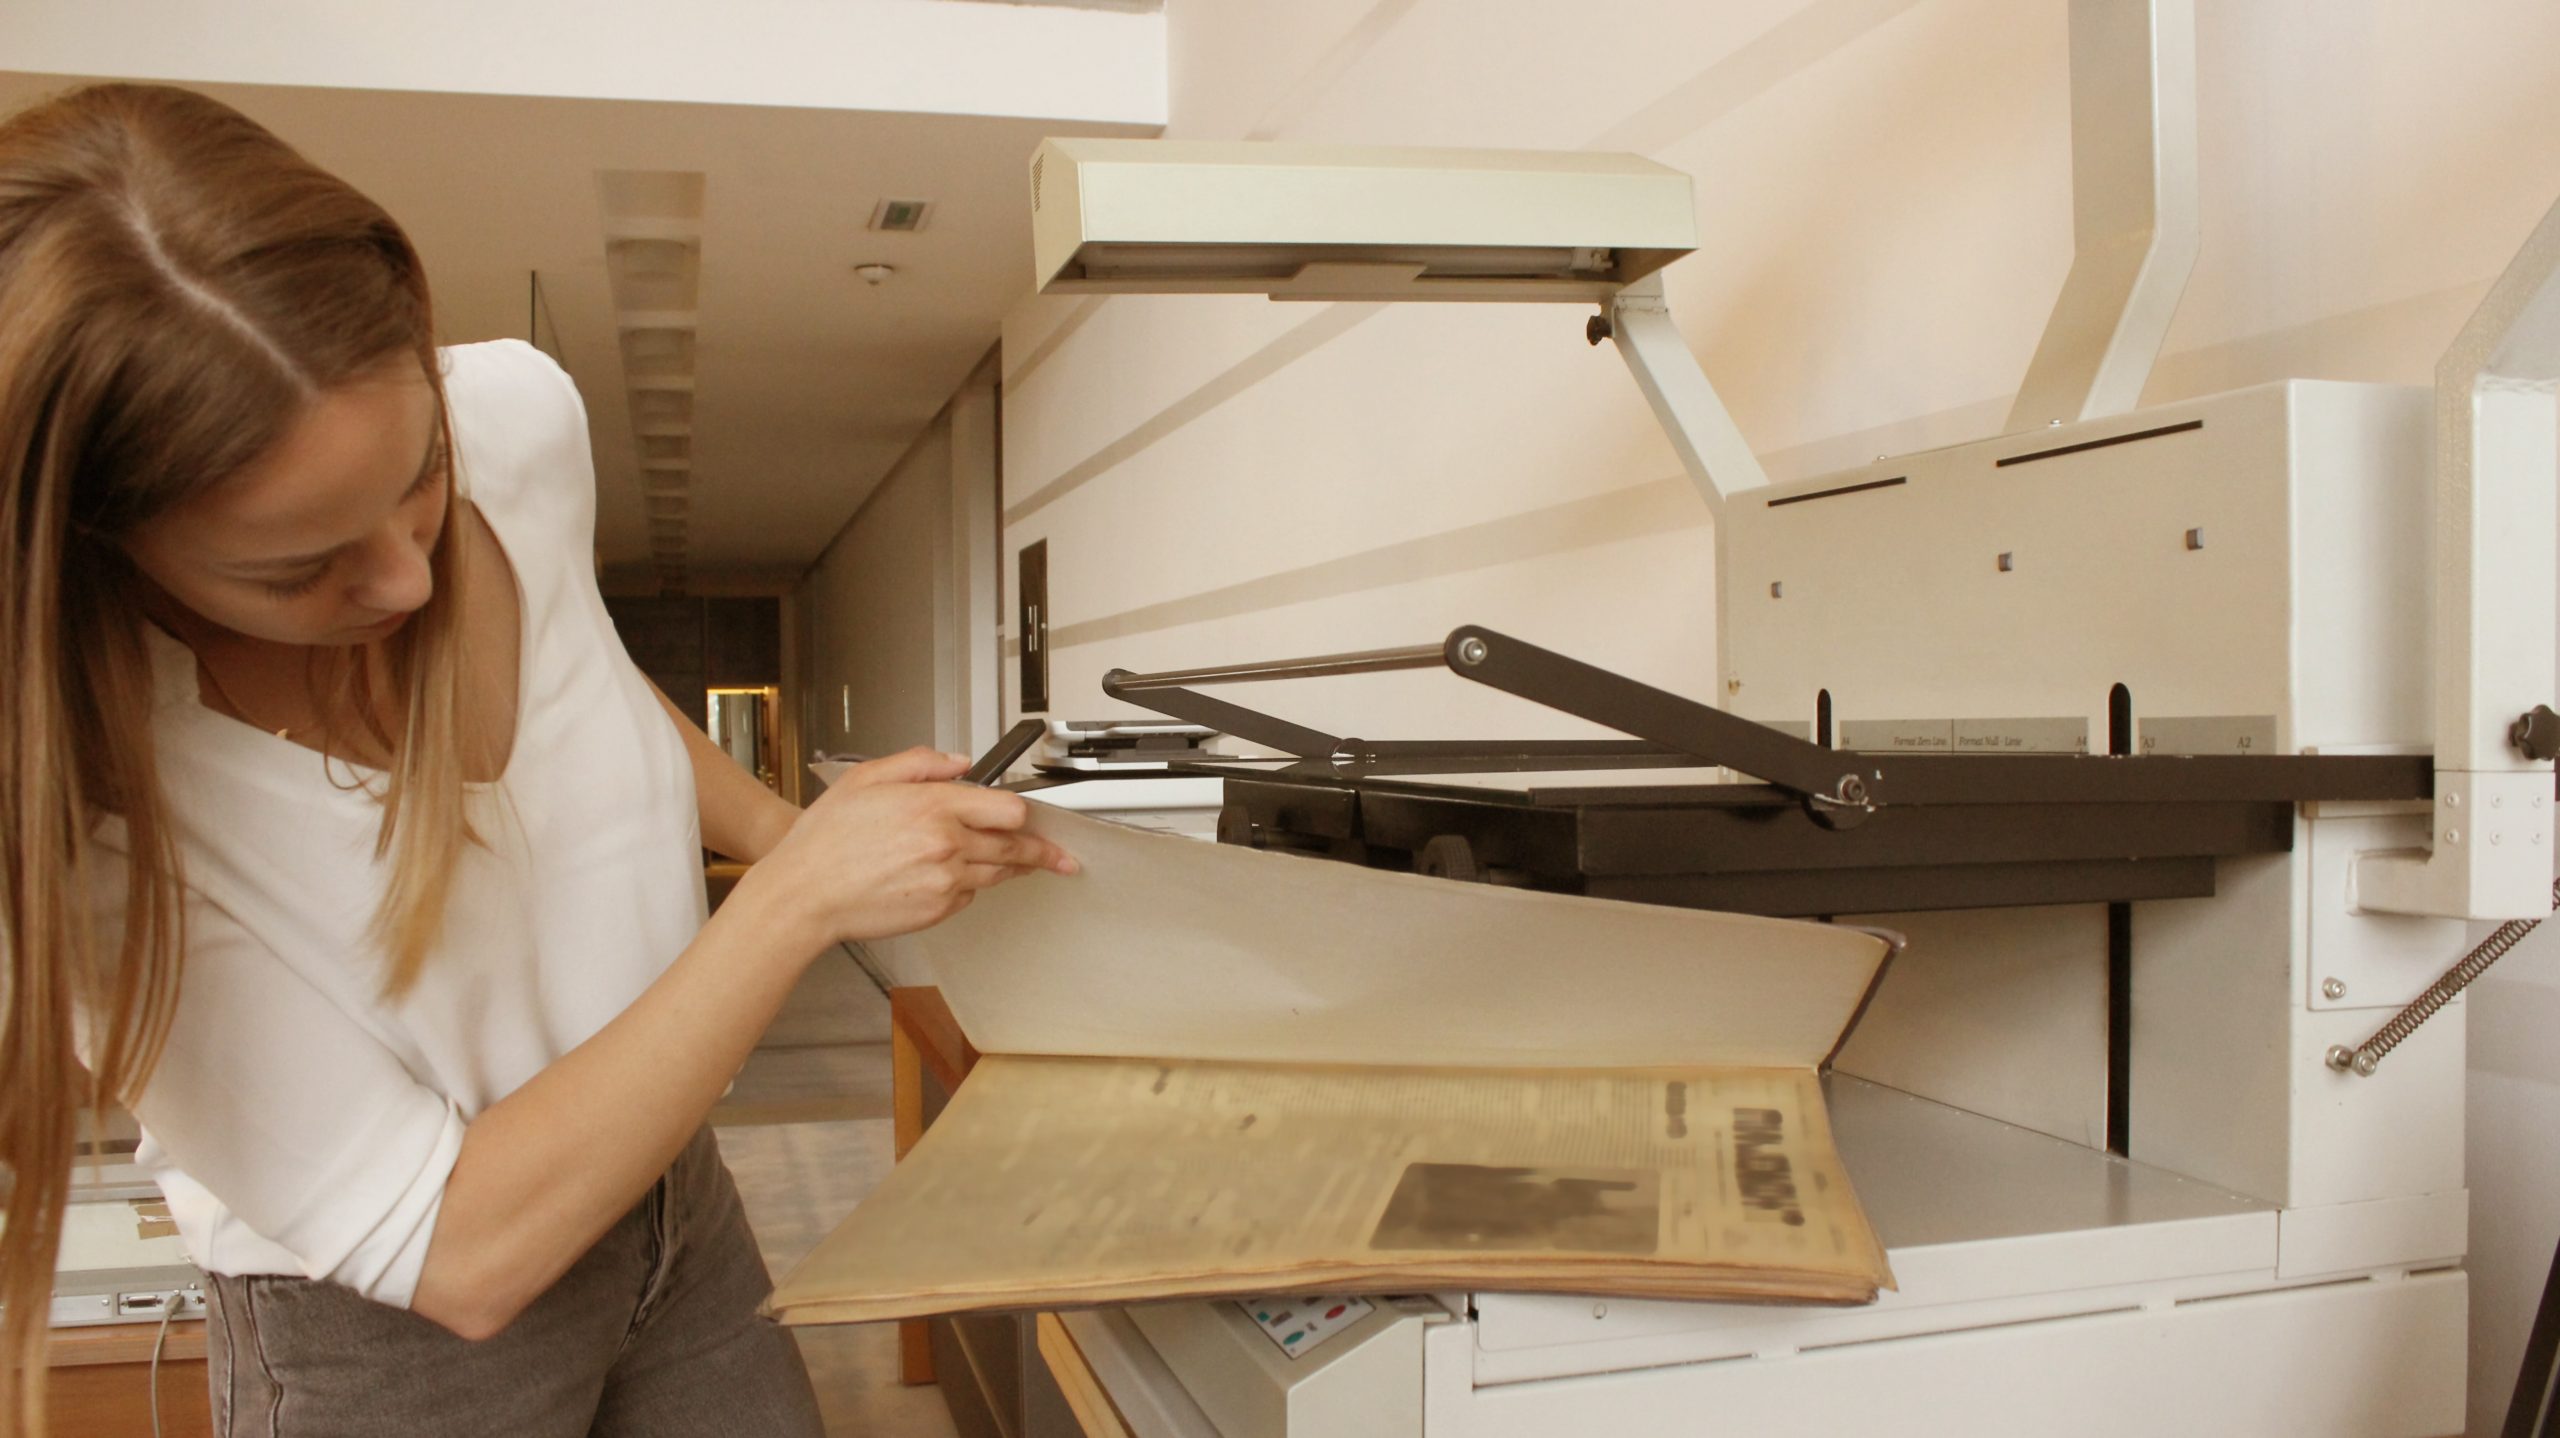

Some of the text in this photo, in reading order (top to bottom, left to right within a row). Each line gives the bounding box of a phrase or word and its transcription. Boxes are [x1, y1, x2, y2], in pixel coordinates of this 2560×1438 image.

[1959, 735, 1983, 746] Format
[2075, 735, 2087, 747] A4
[2142, 735, 2155, 748] A3
[2237, 736, 2251, 748] A2
